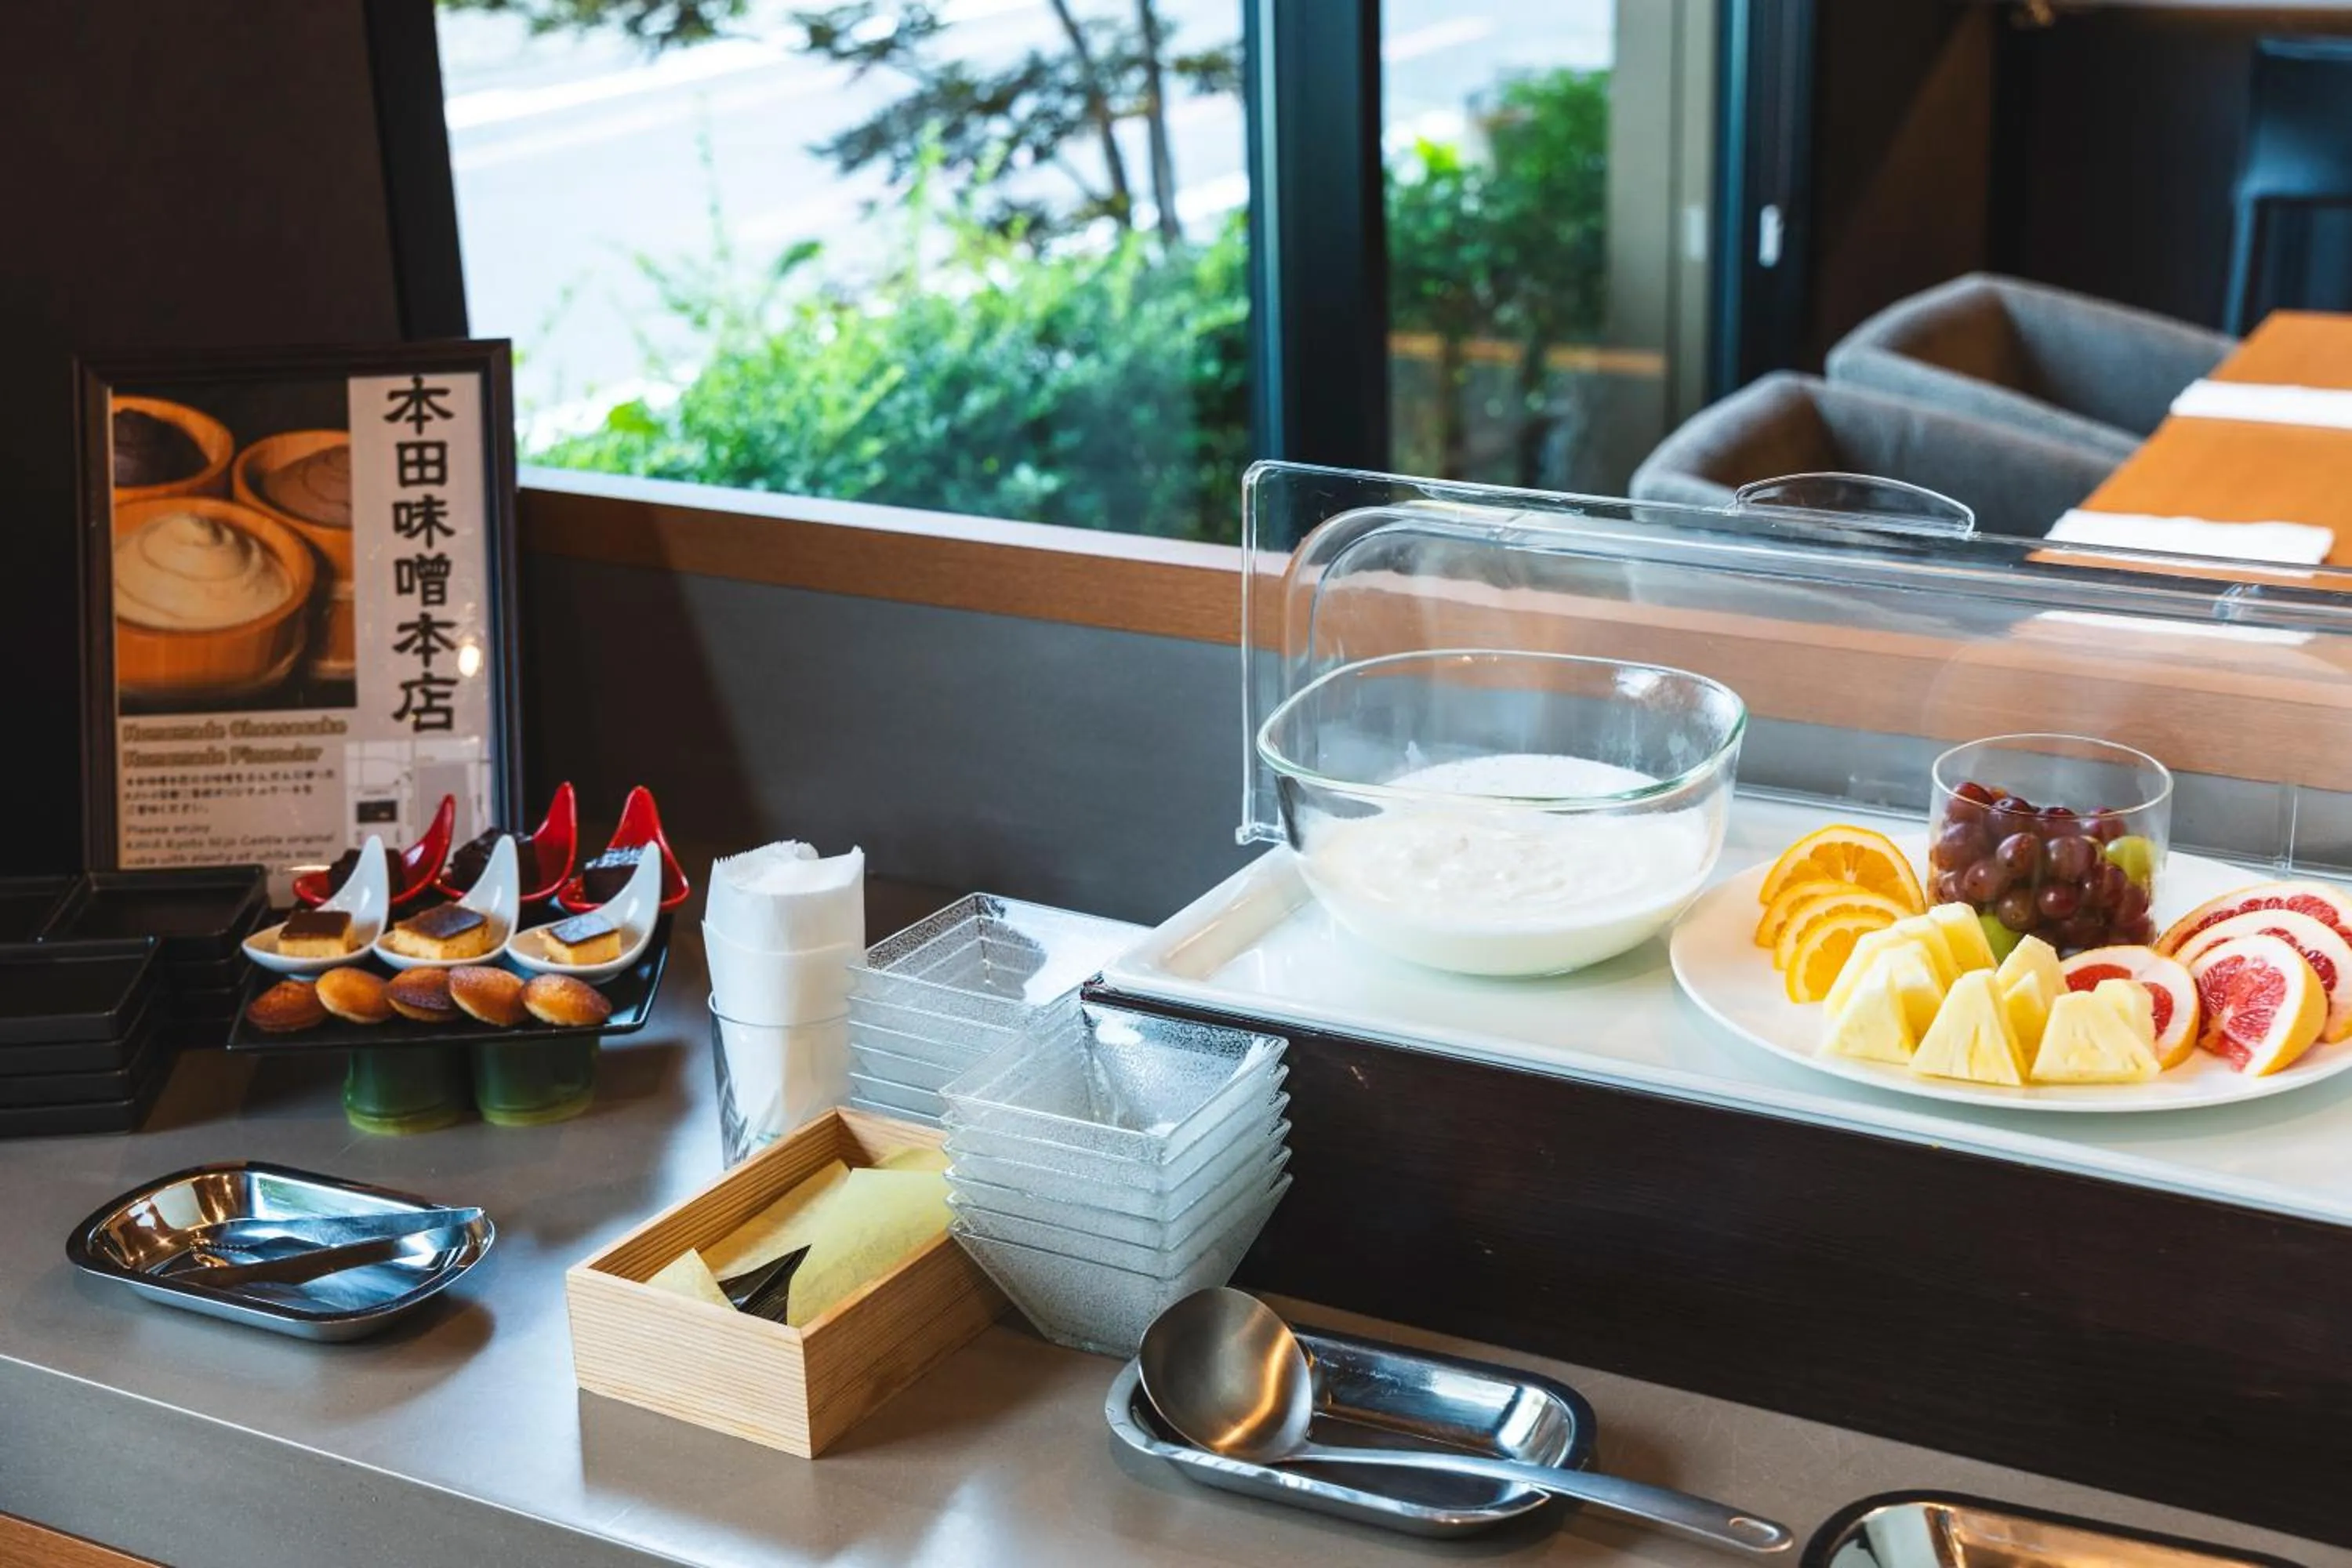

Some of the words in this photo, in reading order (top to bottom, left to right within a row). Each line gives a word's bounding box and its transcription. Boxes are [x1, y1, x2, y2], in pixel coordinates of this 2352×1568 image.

[383, 375, 459, 732] 本田味噌本店
